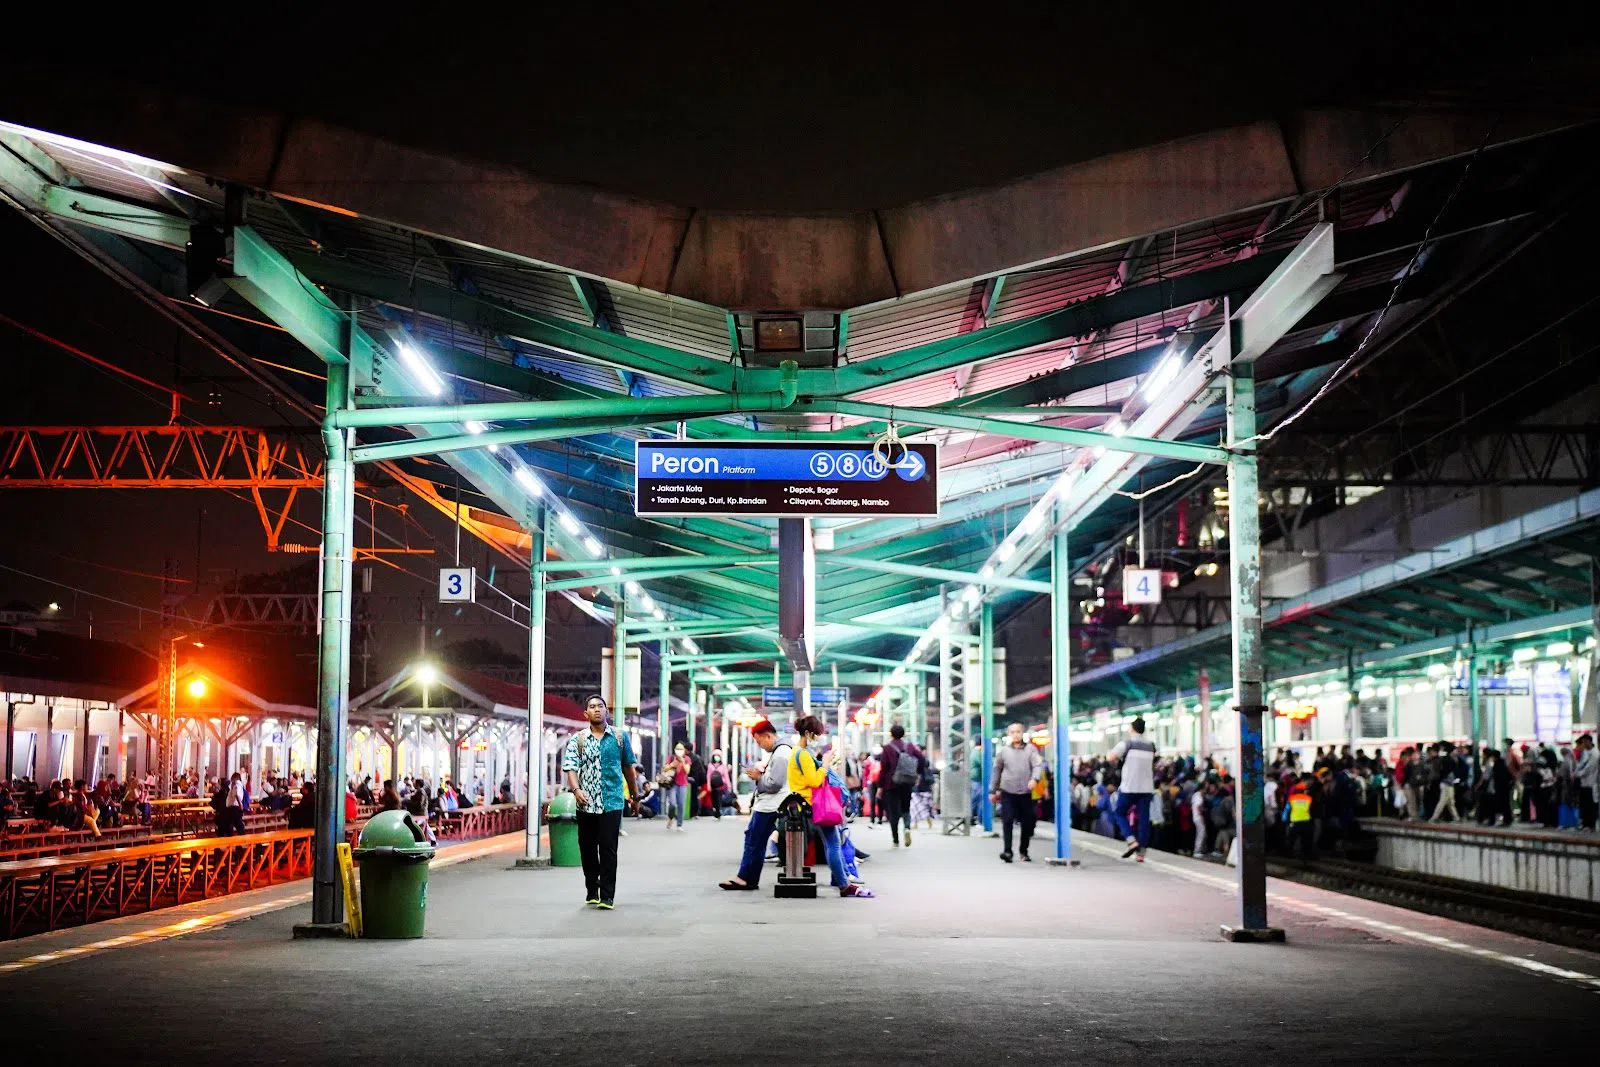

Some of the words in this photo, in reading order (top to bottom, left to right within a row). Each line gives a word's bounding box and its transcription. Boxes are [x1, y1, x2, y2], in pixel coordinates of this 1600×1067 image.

[651, 452, 719, 474] Peron
[722, 465, 756, 474] Platform
[816, 457, 828, 473] 5
[843, 456, 854, 473] 8
[866, 458, 883, 473] 10
[656, 484, 685, 493] Jakarta
[685, 484, 703, 493] Kota
[789, 486, 816, 495] Depok,
[816, 486, 839, 495] Bogor
[656, 496, 679, 504] Tanah
[680, 496, 707, 506] Abang,
[708, 496, 726, 505] Duri,
[789, 497, 823, 507] Citayam,
[824, 498, 860, 508] Cibinong,
[861, 498, 890, 507] Nambo
[447, 574, 462, 595] 3
[1136, 575, 1151, 596] 4
